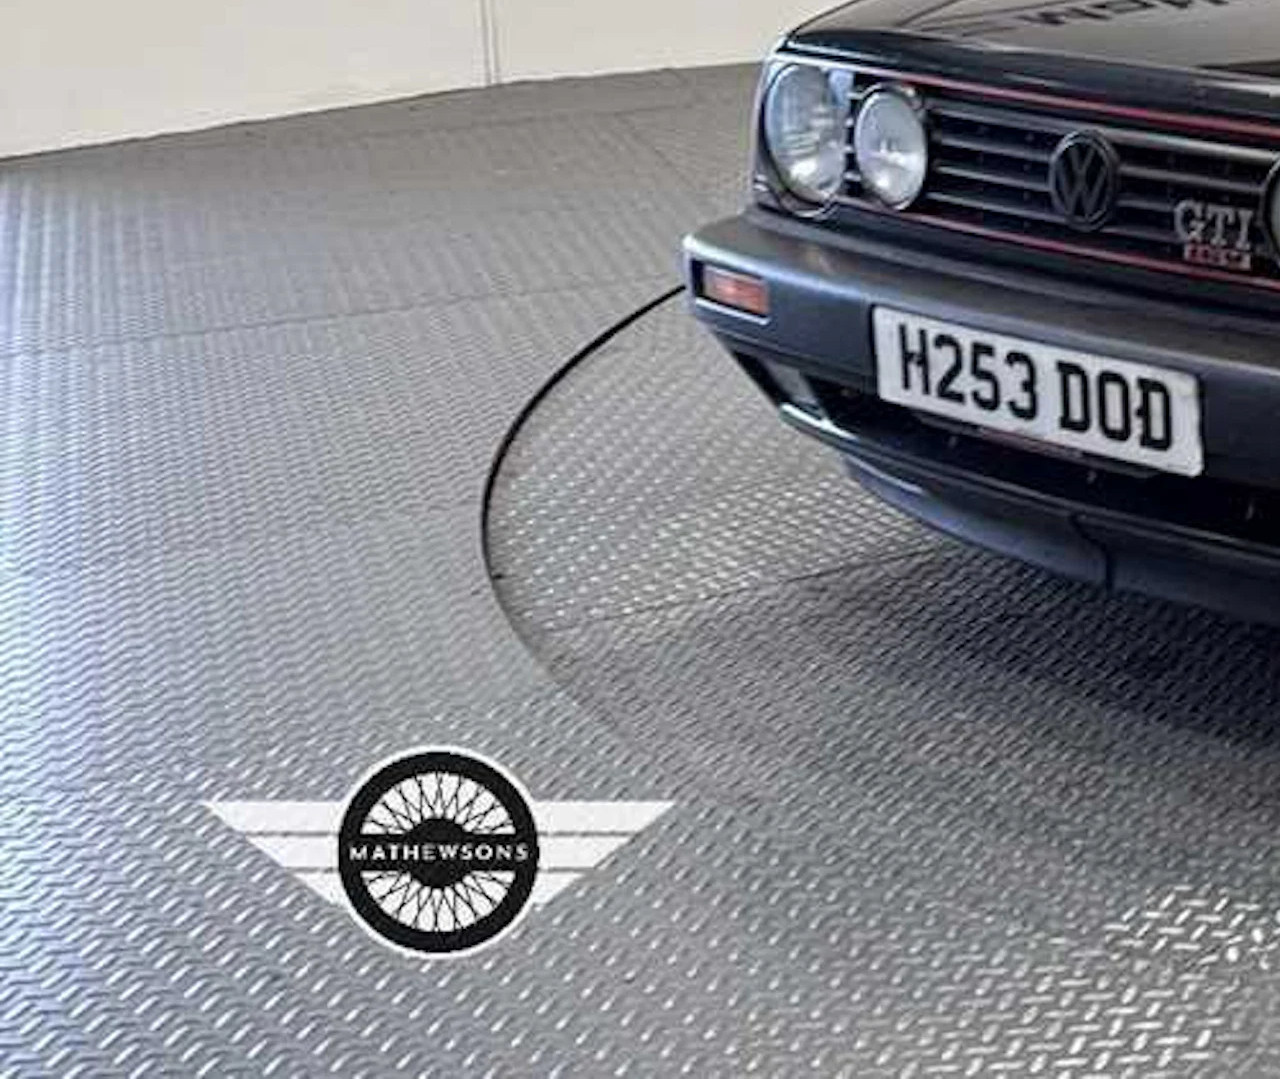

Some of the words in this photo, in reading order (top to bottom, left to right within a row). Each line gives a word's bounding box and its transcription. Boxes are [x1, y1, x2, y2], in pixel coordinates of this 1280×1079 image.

[1173, 199, 1253, 251] GTI
[899, 323, 1038, 421] H253
[1056, 360, 1172, 451] DOD
